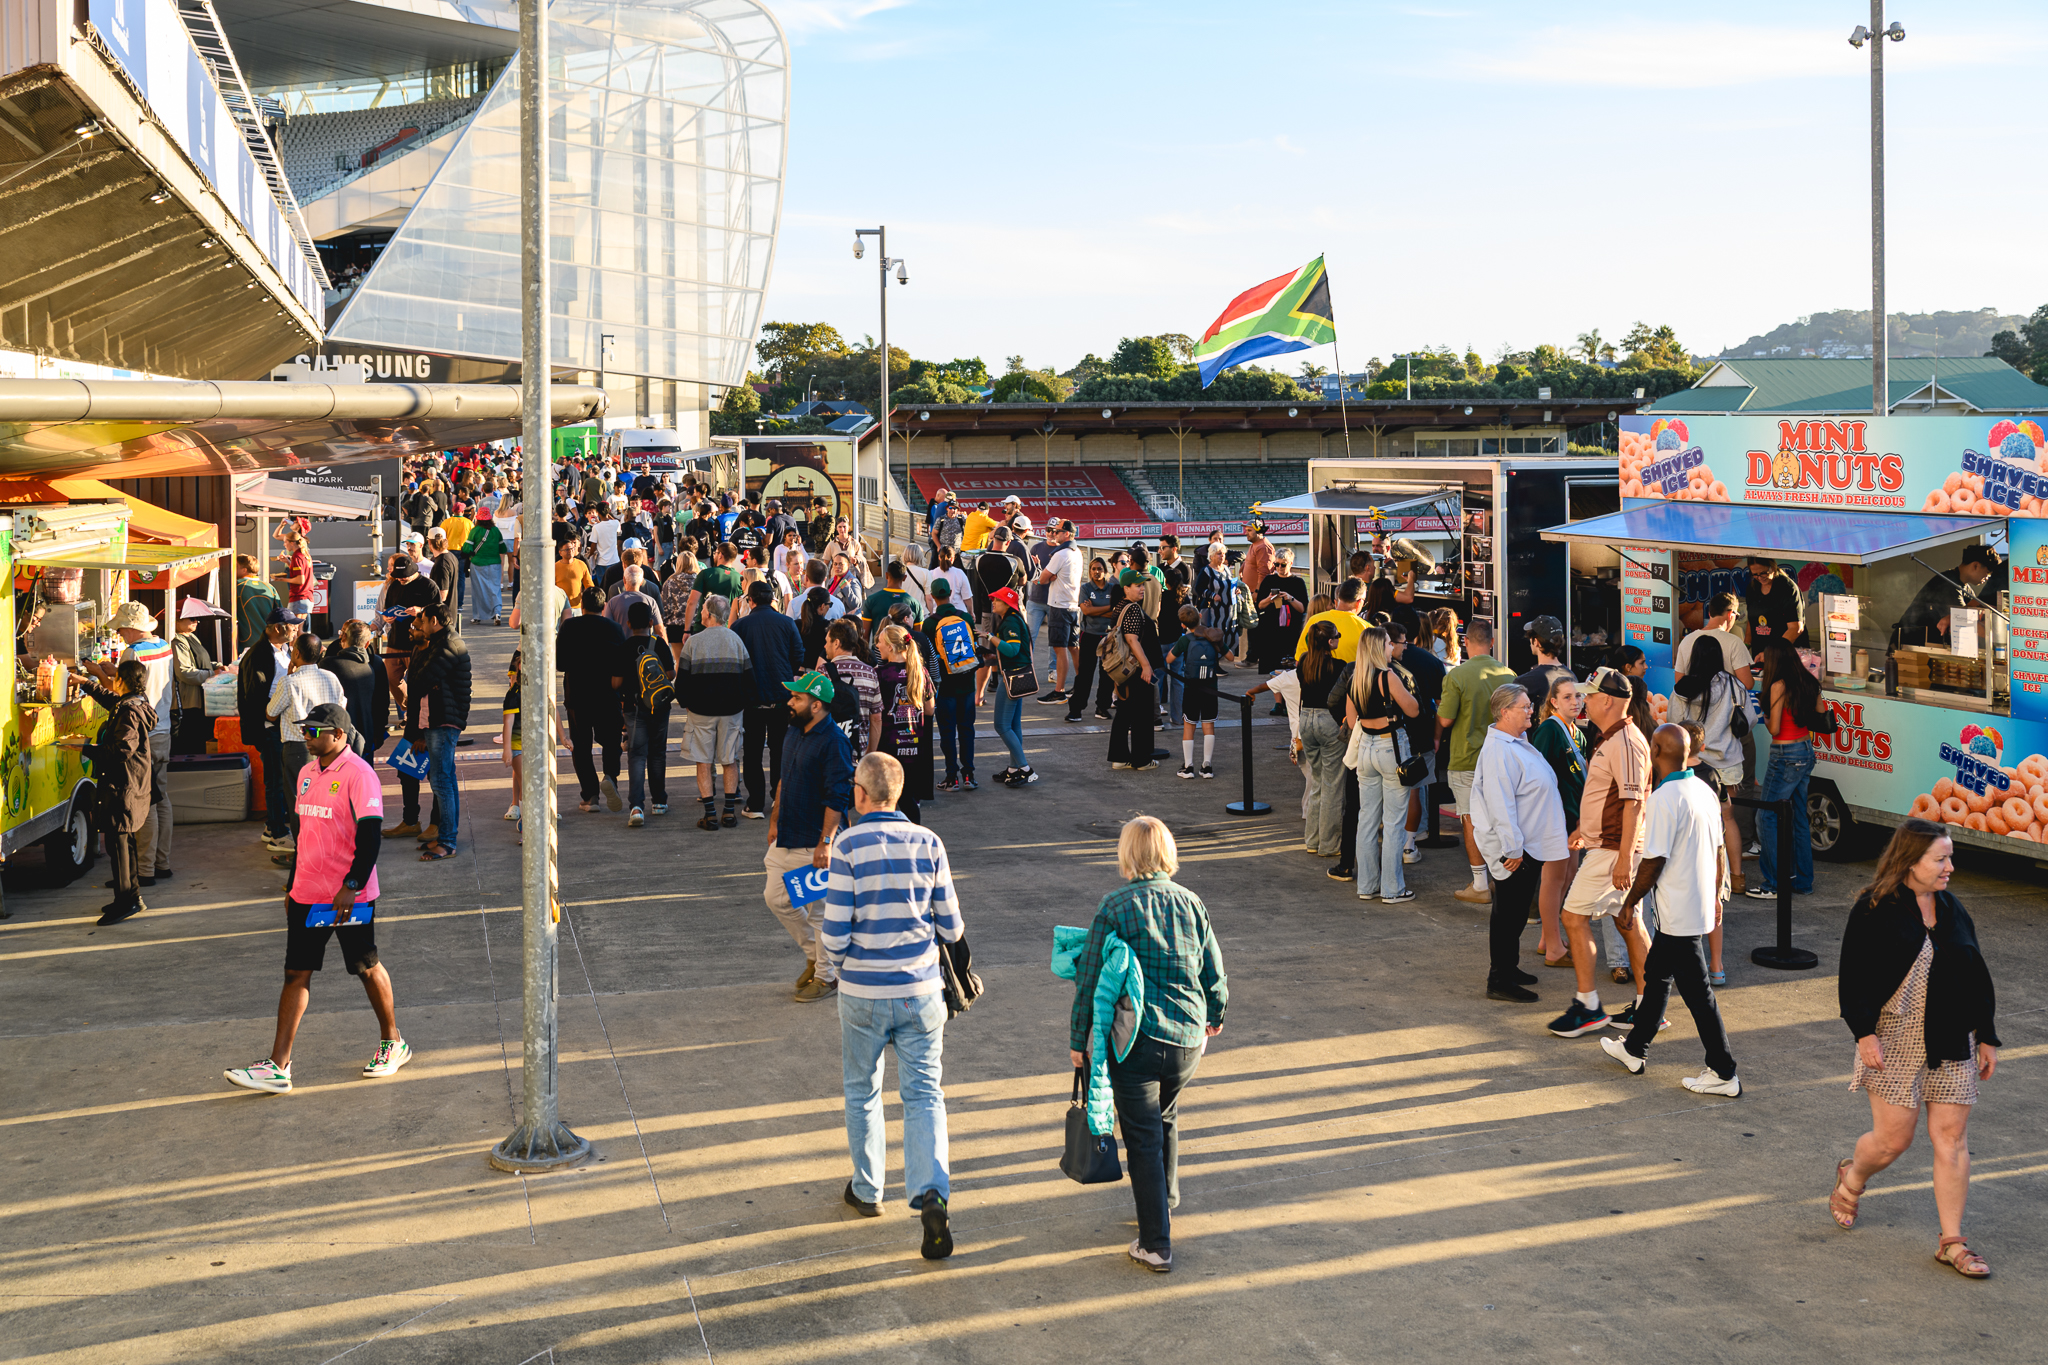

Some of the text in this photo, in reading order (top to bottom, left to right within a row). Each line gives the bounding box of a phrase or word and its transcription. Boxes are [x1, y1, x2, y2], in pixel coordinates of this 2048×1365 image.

[1778, 420, 1867, 452] MINI
[1641, 446, 1704, 487] SHAVED
[1961, 449, 2048, 500] SHAVED
[953, 479, 1087, 488] KENNARDS
[1661, 470, 1690, 496] ICE
[1744, 490, 1905, 507] ALWAYS FRESH AND DELICIOUS
[1982, 478, 2022, 511] ICE
[1383, 520, 1400, 528] HIRE
[1418, 519, 1458, 527] KENNARDS
[1096, 526, 1161, 535] KENNARDS HIRE
[1178, 524, 1242, 534] KENNARDS HIRE
[1625, 570, 1651, 579] DONUTS
[1654, 565, 1664, 576] $7
[2012, 566, 2048, 584] ME
[1625, 587, 1651, 597] BUCKET
[1633, 597, 1643, 605] OF
[2013, 595, 2034, 606] BAG
[1625, 605, 1652, 615] DONUTS
[1625, 623, 1652, 632] SHAVED
[1633, 632, 1645, 641] ICE
[1656, 630, 1665, 641] $5
[952, 635, 968, 655] 4
[2024, 640, 2039, 649] OF
[2022, 682, 2041, 693] ICE
[1812, 726, 1892, 760] NUTS
[897, 747, 918, 755] FREYA
[395, 748, 418, 768] 4
[1815, 752, 1893, 773] ESH AND DELICIOUS
[1939, 742, 2010, 791] SHAVED
[1956, 769, 1987, 797] ICE
